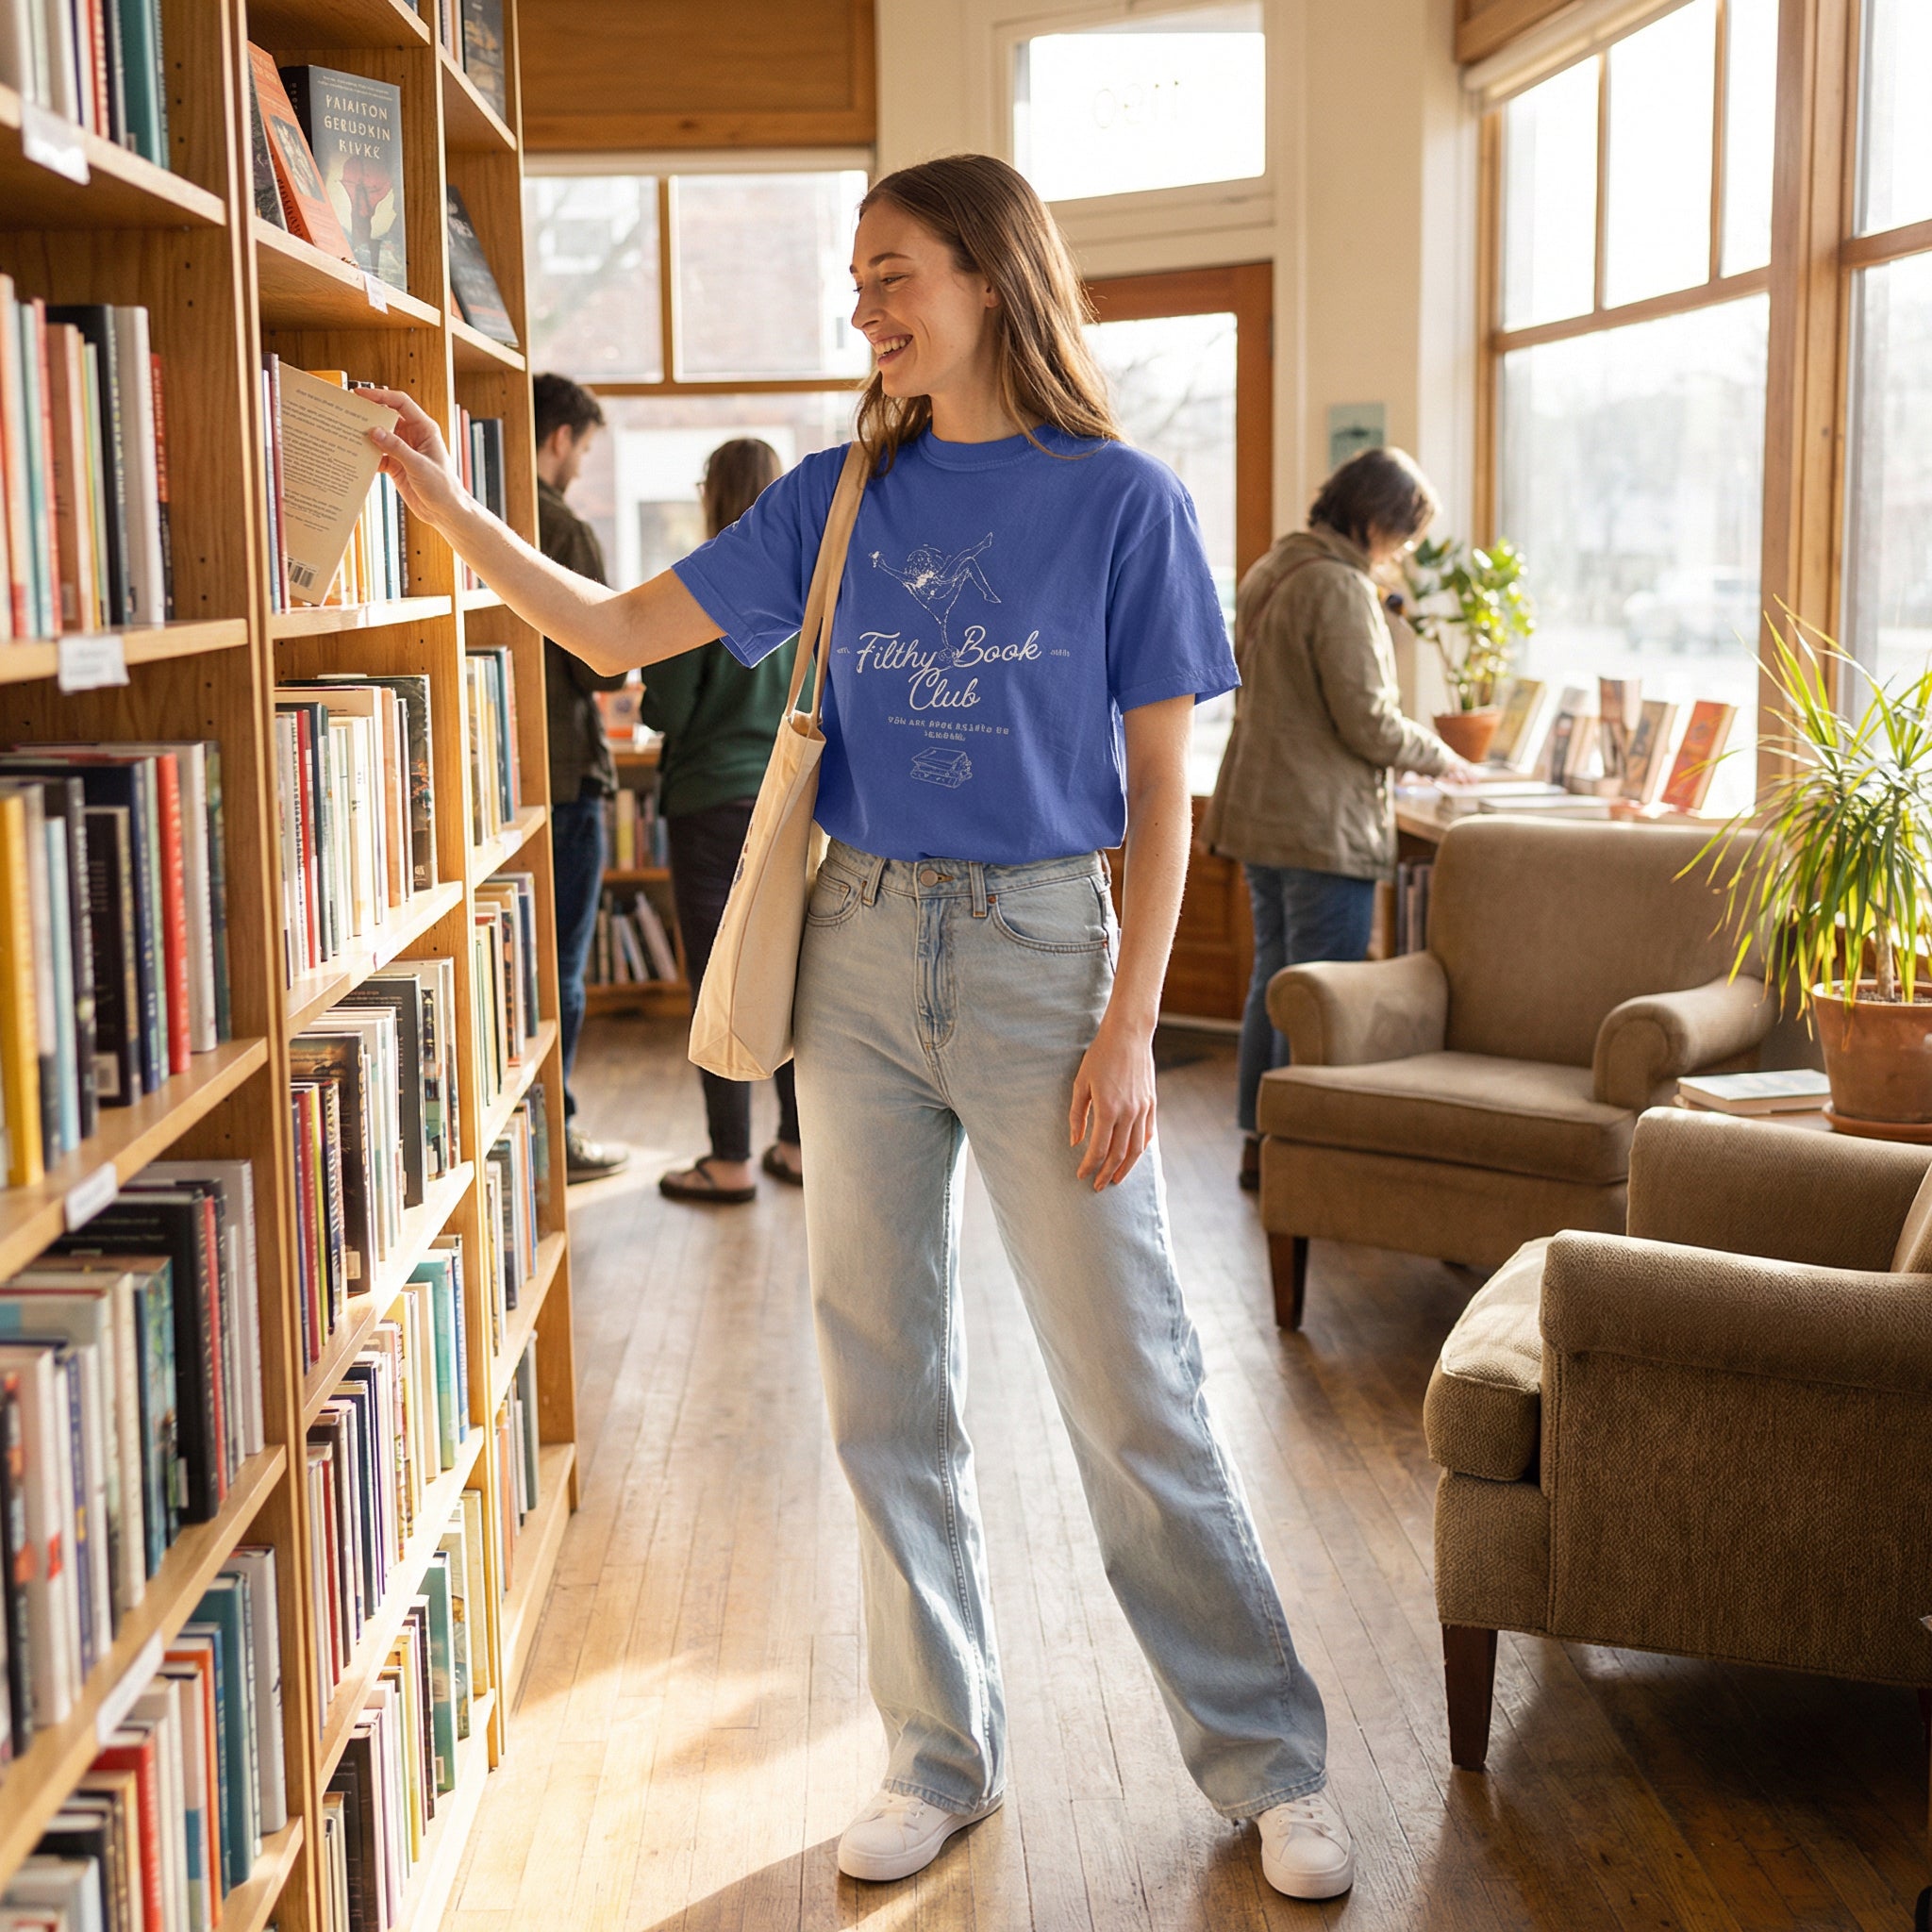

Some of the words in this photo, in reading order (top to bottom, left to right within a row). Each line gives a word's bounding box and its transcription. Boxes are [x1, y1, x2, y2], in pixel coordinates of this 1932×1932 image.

[856, 631, 937, 674] Filthy
[953, 625, 1041, 668] Book
[908, 666, 981, 710] Club
